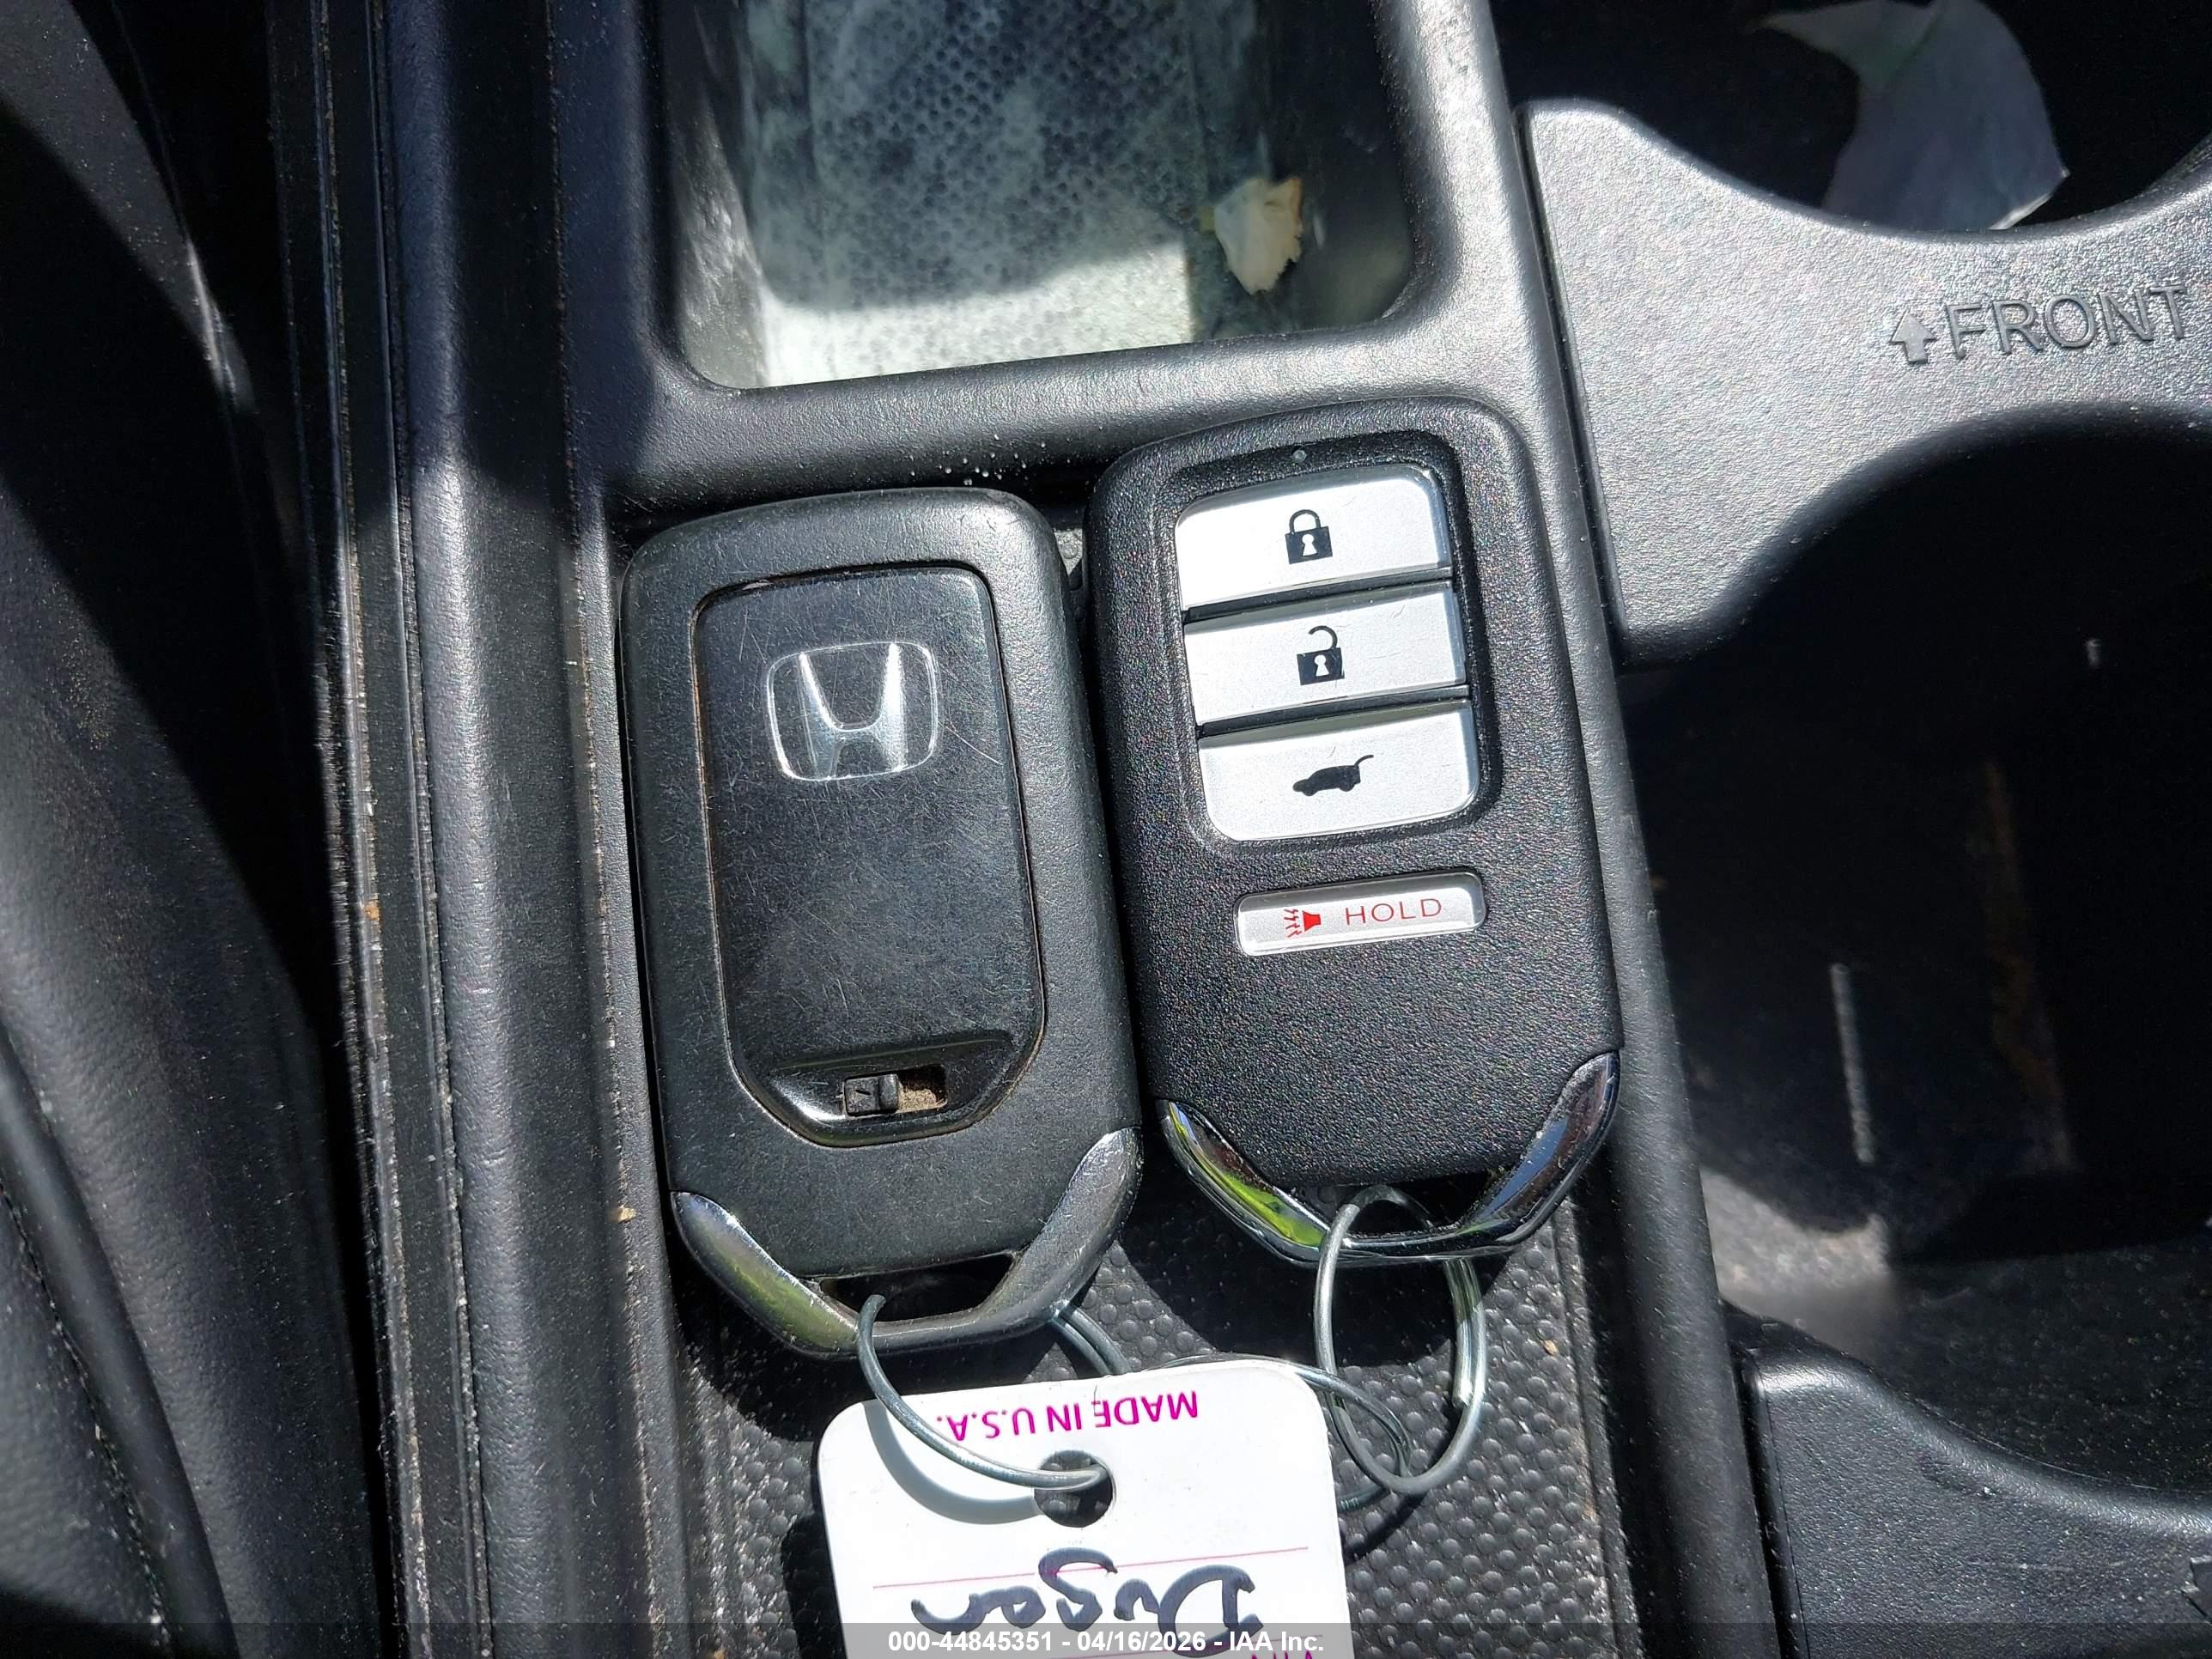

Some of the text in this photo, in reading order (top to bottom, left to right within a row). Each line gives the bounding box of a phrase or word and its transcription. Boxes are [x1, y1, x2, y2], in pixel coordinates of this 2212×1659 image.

[1946, 284, 2187, 359] FRONT
[1345, 897, 1443, 926] HOLD
[936, 1391, 1199, 1441] MADE IN U.S.A.
